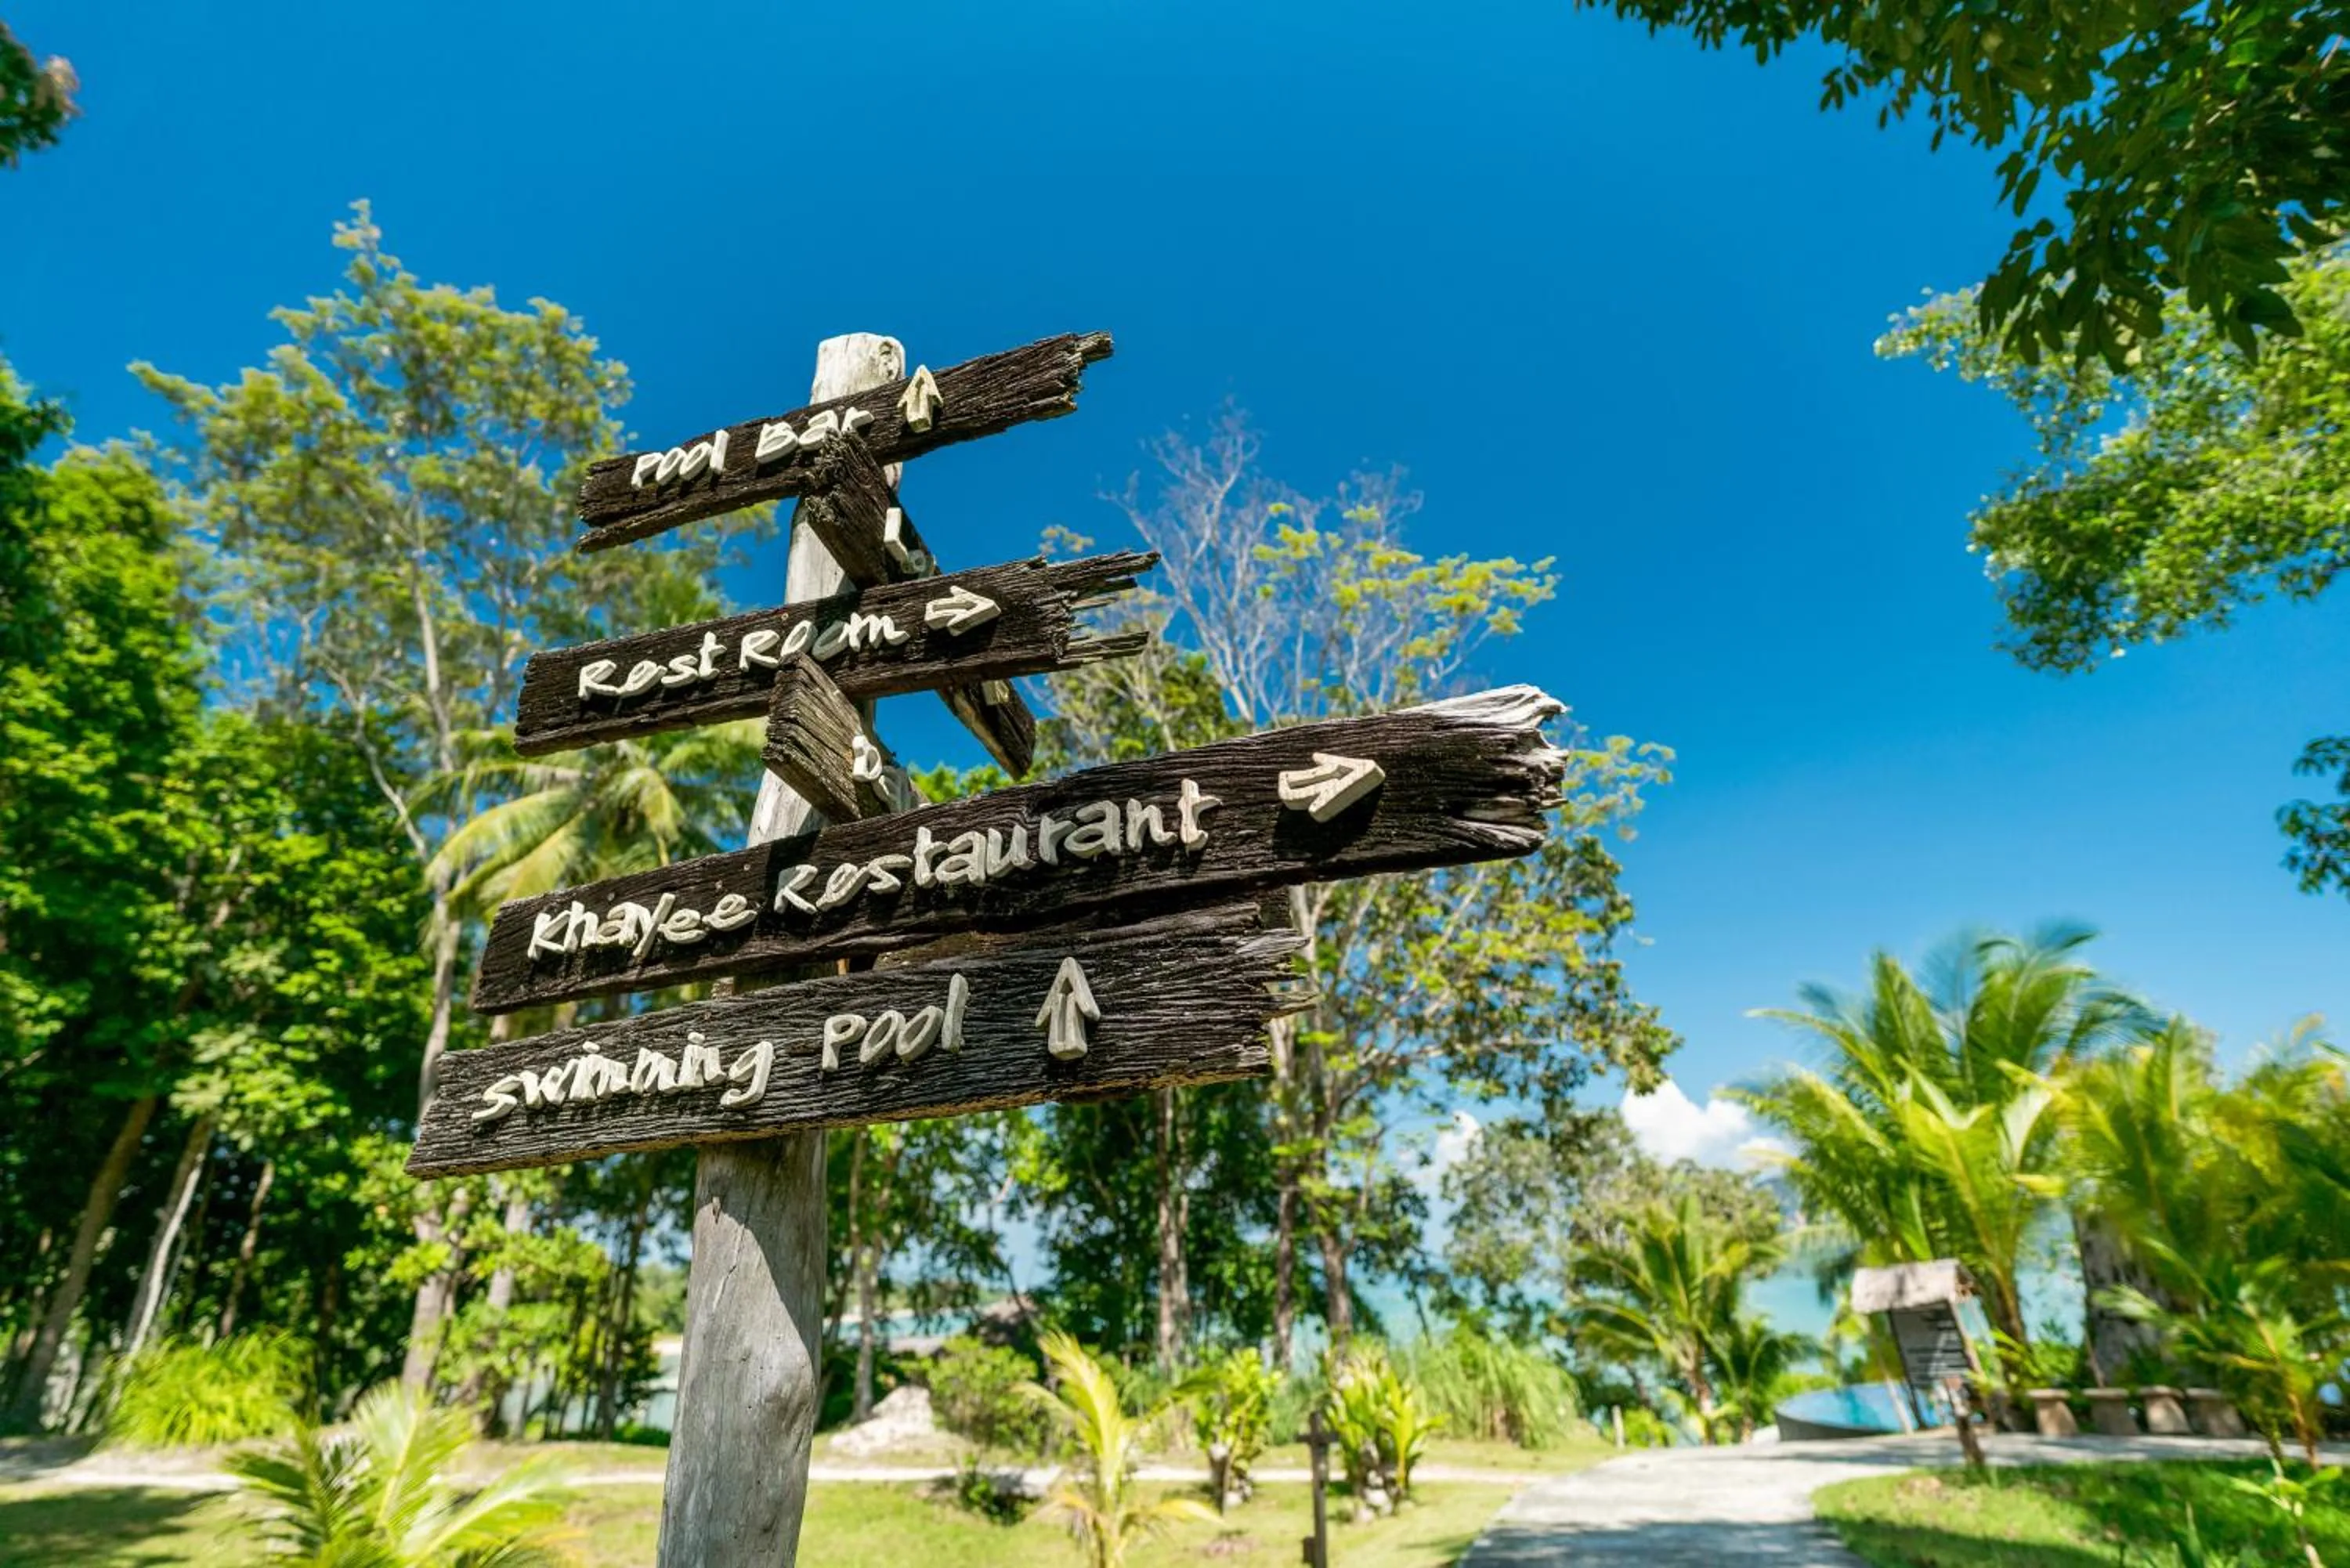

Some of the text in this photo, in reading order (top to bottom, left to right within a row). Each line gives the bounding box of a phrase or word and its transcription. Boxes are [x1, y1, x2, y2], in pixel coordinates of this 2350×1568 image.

[754, 406, 875, 464] Bar
[578, 612, 909, 700] Rest Room
[774, 778, 1223, 915] Restaurant
